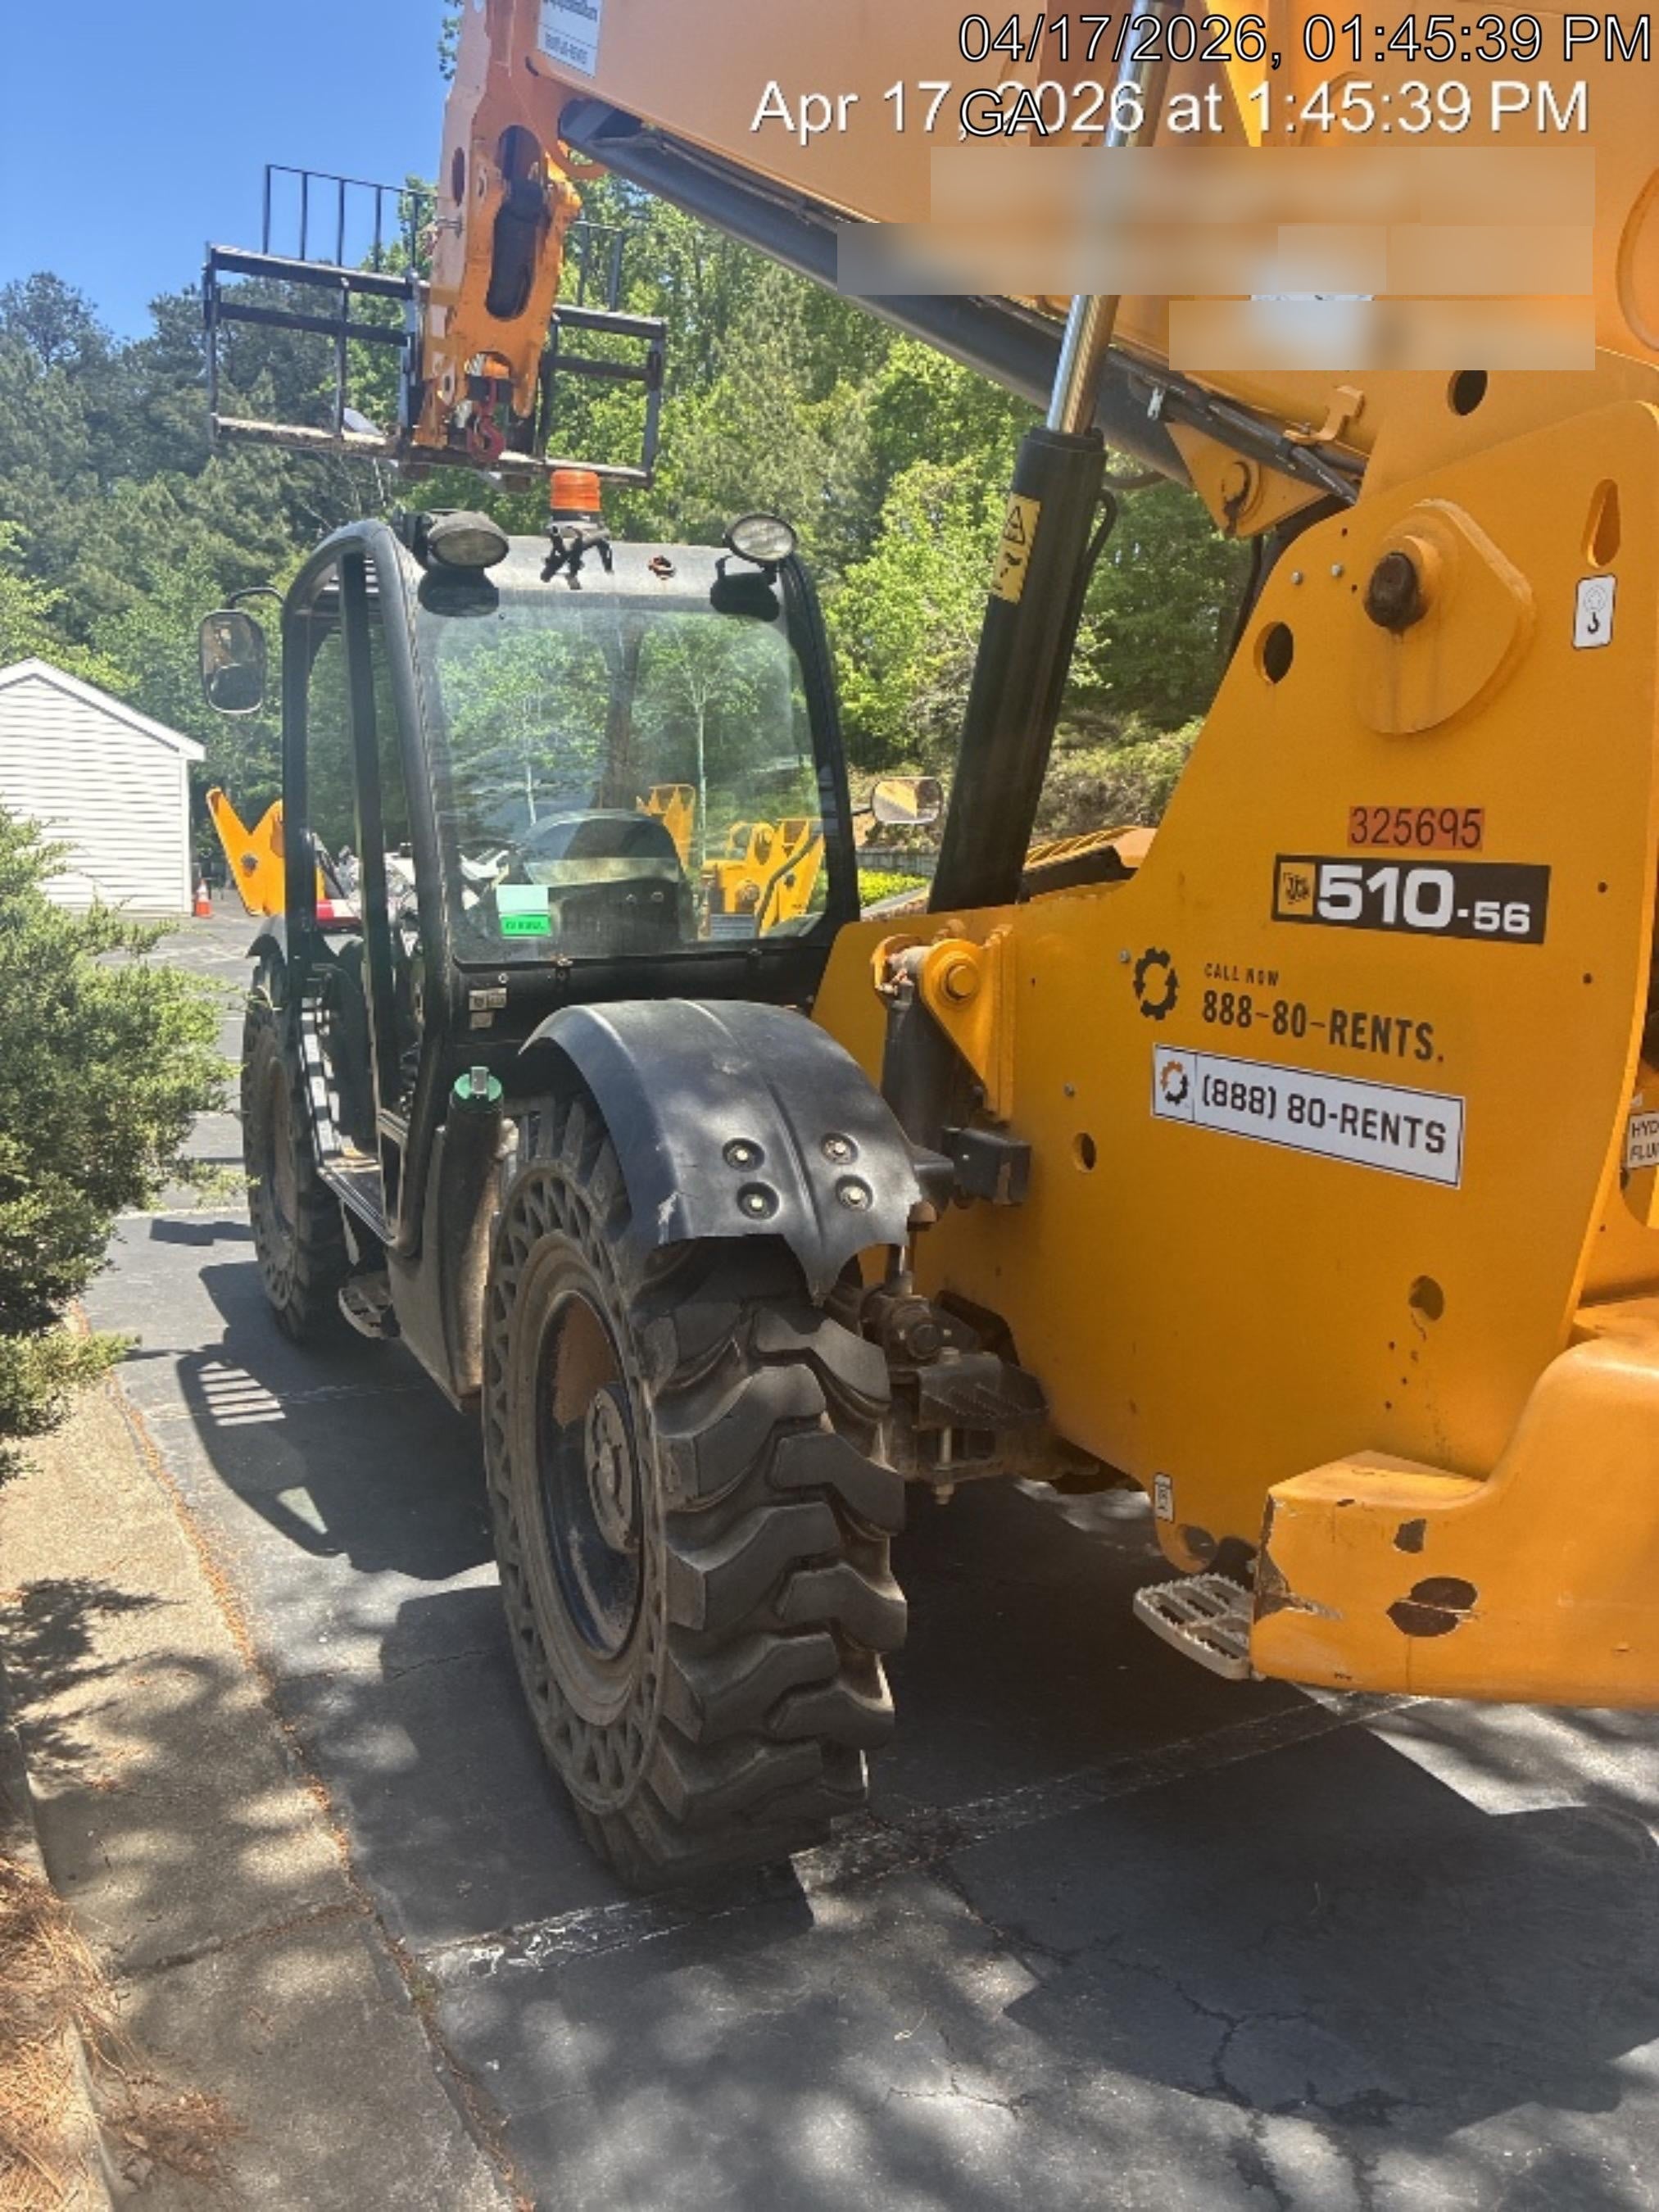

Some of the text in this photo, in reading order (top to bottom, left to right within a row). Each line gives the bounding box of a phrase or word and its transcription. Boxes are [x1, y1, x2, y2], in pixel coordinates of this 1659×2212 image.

[1351, 805, 1481, 849] 325695
[1203, 963, 1280, 986] CALL NOW
[1202, 989, 1444, 1063] 888-80-RENTS.
[1202, 1074, 1447, 1154] (888) 80-RENTS
[1630, 1142, 1659, 1161] FLU
